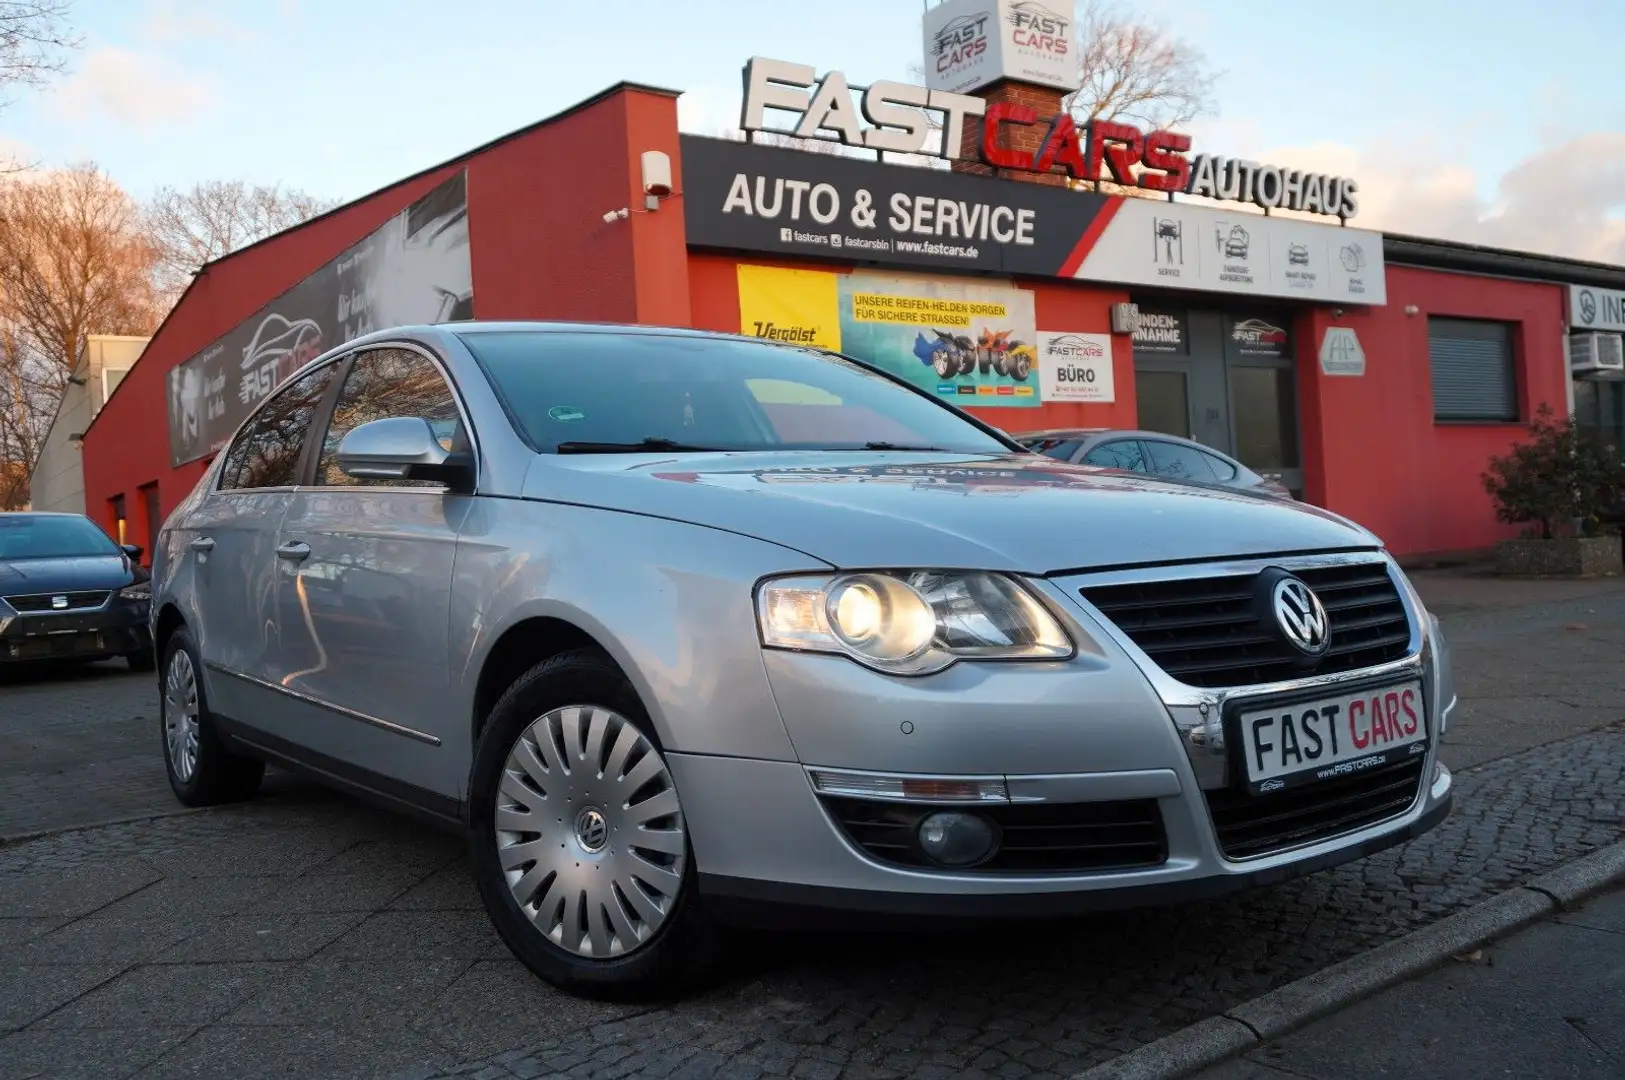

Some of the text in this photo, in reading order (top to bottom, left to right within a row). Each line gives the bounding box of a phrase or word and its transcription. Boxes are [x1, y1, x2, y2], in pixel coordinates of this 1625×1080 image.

[938, 16, 989, 53] FAST
[1016, 11, 1068, 36] FAST
[937, 36, 988, 73] CARS
[1013, 30, 1068, 55] CARS
[741, 57, 1358, 218] FAST CARS AUTOHAUS
[722, 173, 1035, 245] AUTO & SERVICE
[794, 233, 828, 244] fastcars
[897, 240, 979, 258] www.fastcars.de
[854, 296, 1005, 316] UNSERE REIFEN-HELDEN SORGEN
[856, 307, 969, 325] FÜR SICHERE STRASSEN!
[753, 321, 816, 342] Vergölst
[1057, 364, 1095, 383] BÜRO
[1253, 689, 1418, 771] FAST CARS
